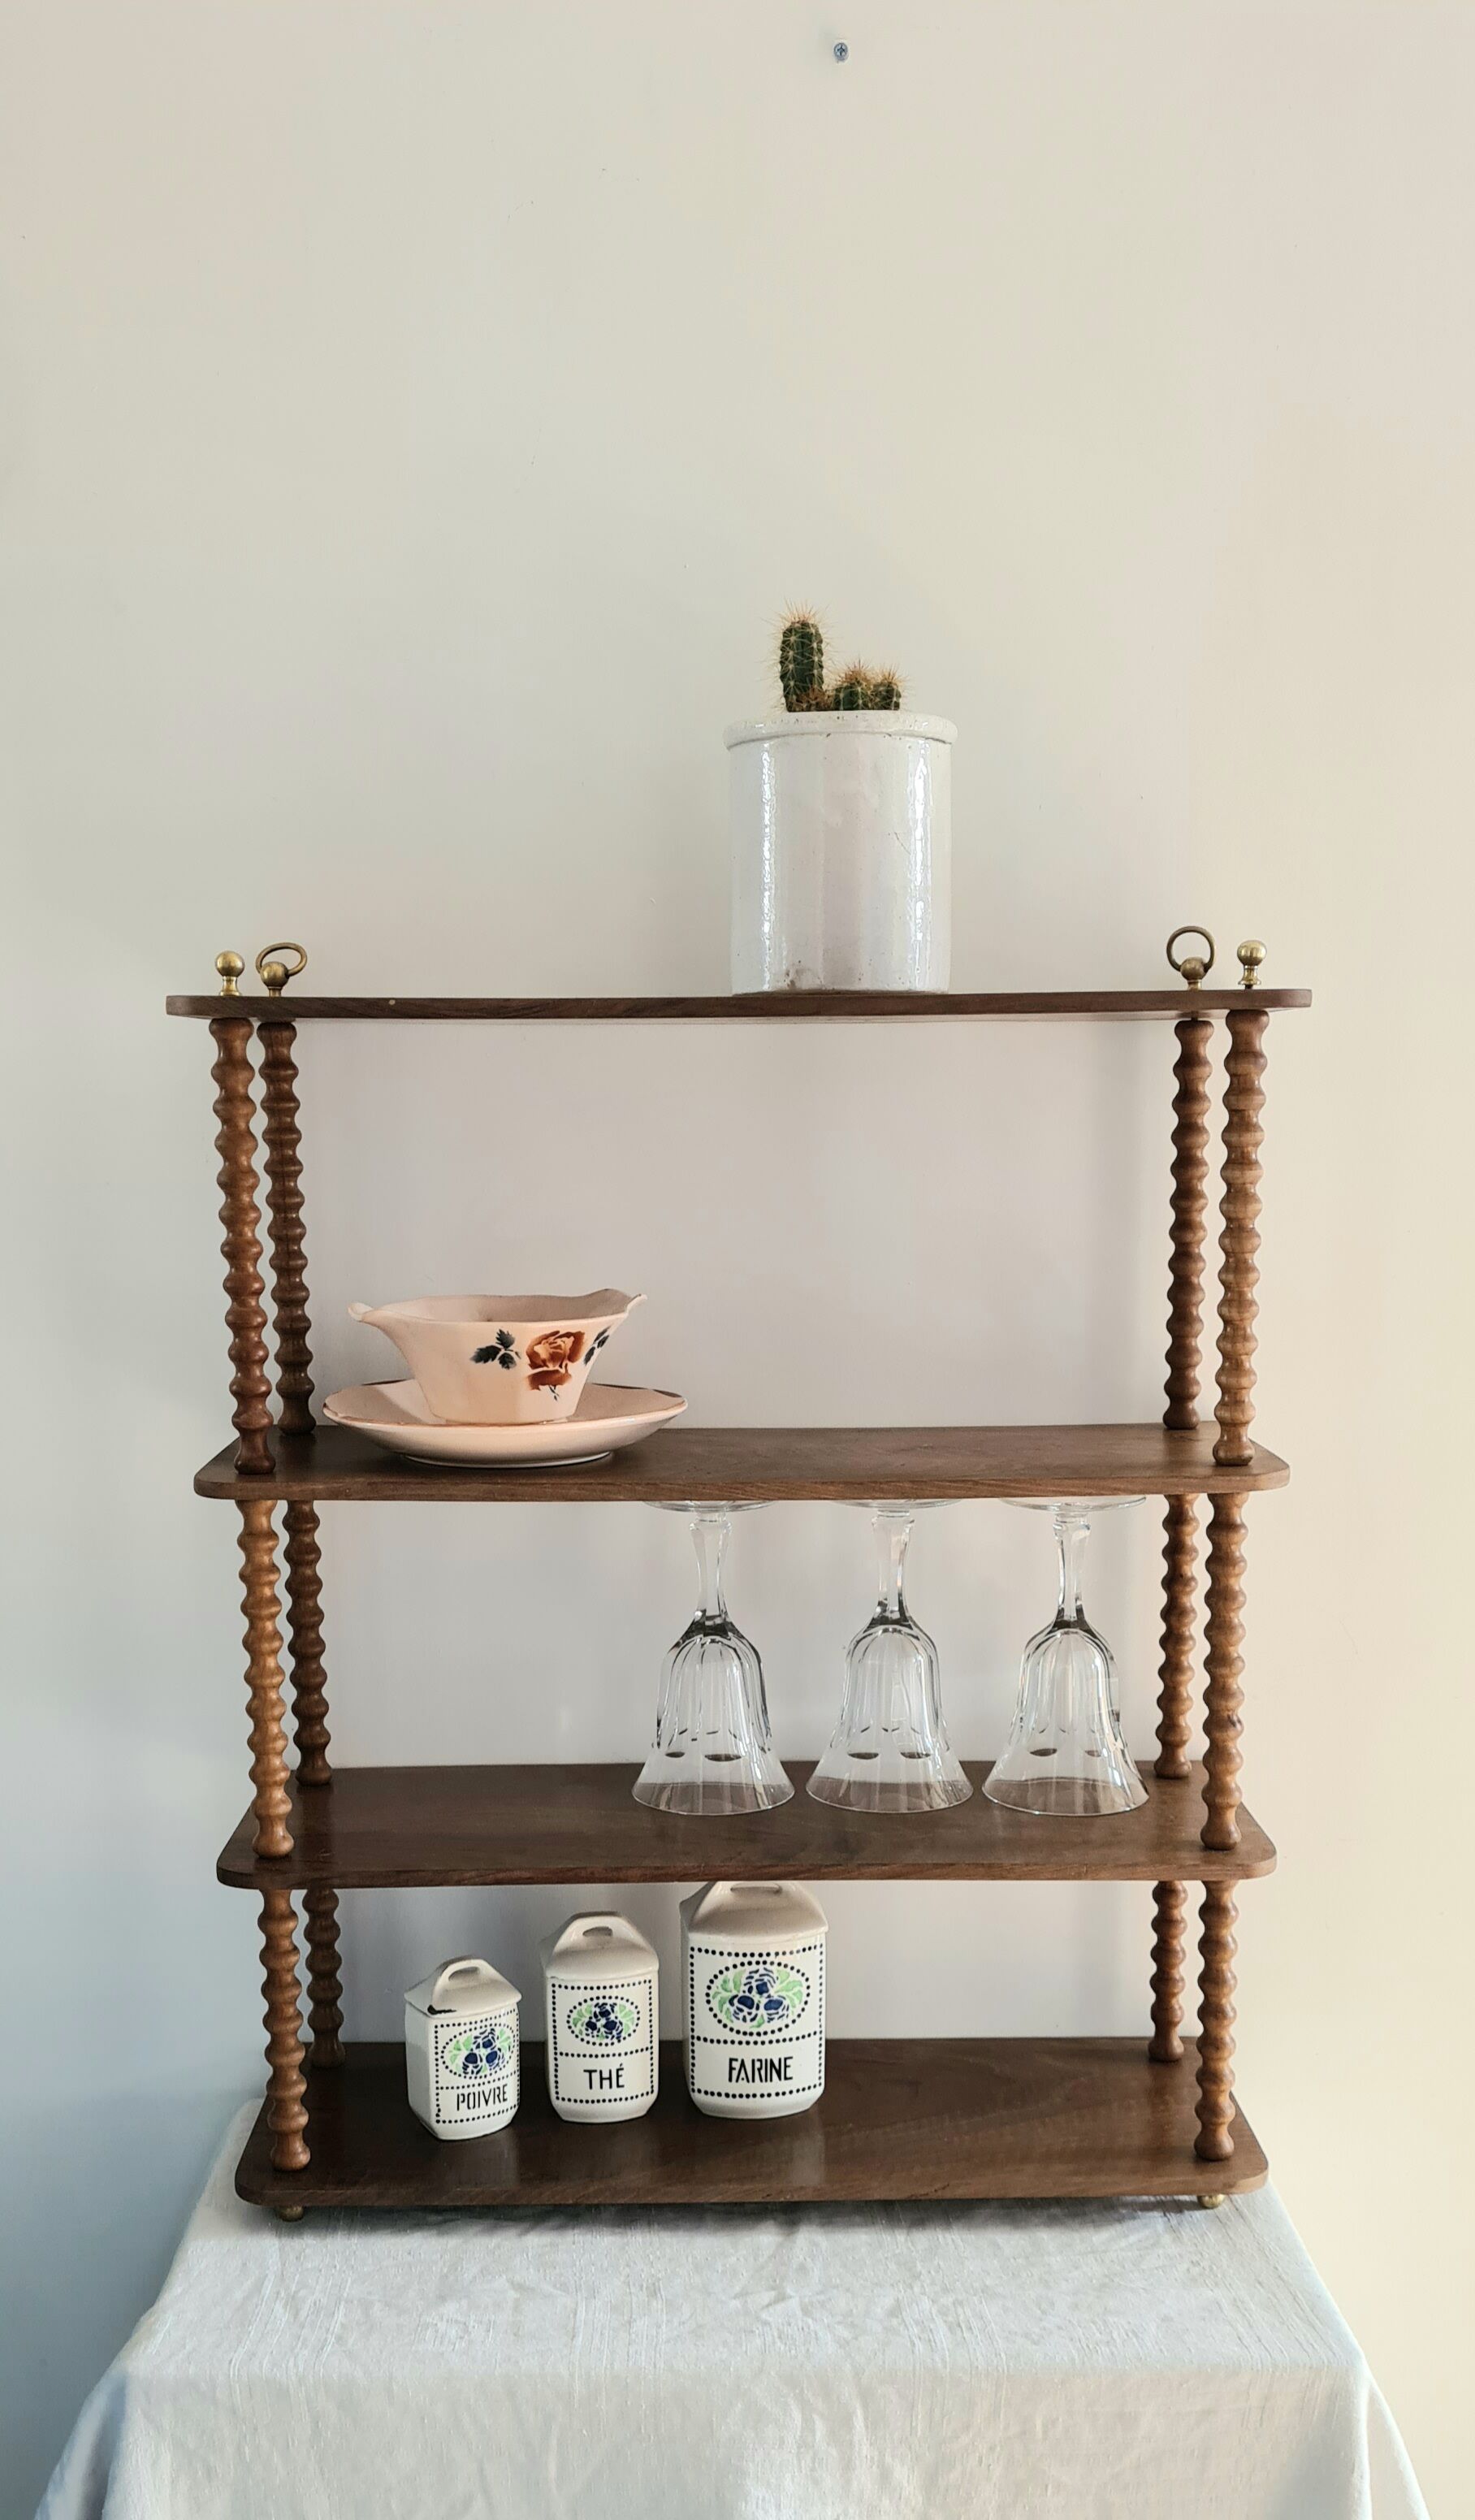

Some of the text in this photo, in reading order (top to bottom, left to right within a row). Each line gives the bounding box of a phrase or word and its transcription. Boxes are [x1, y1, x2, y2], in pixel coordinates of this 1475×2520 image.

[583, 2063, 625, 2090] THÉ
[728, 2056, 794, 2084] FARINE
[456, 2083, 508, 2111] POIVRE
